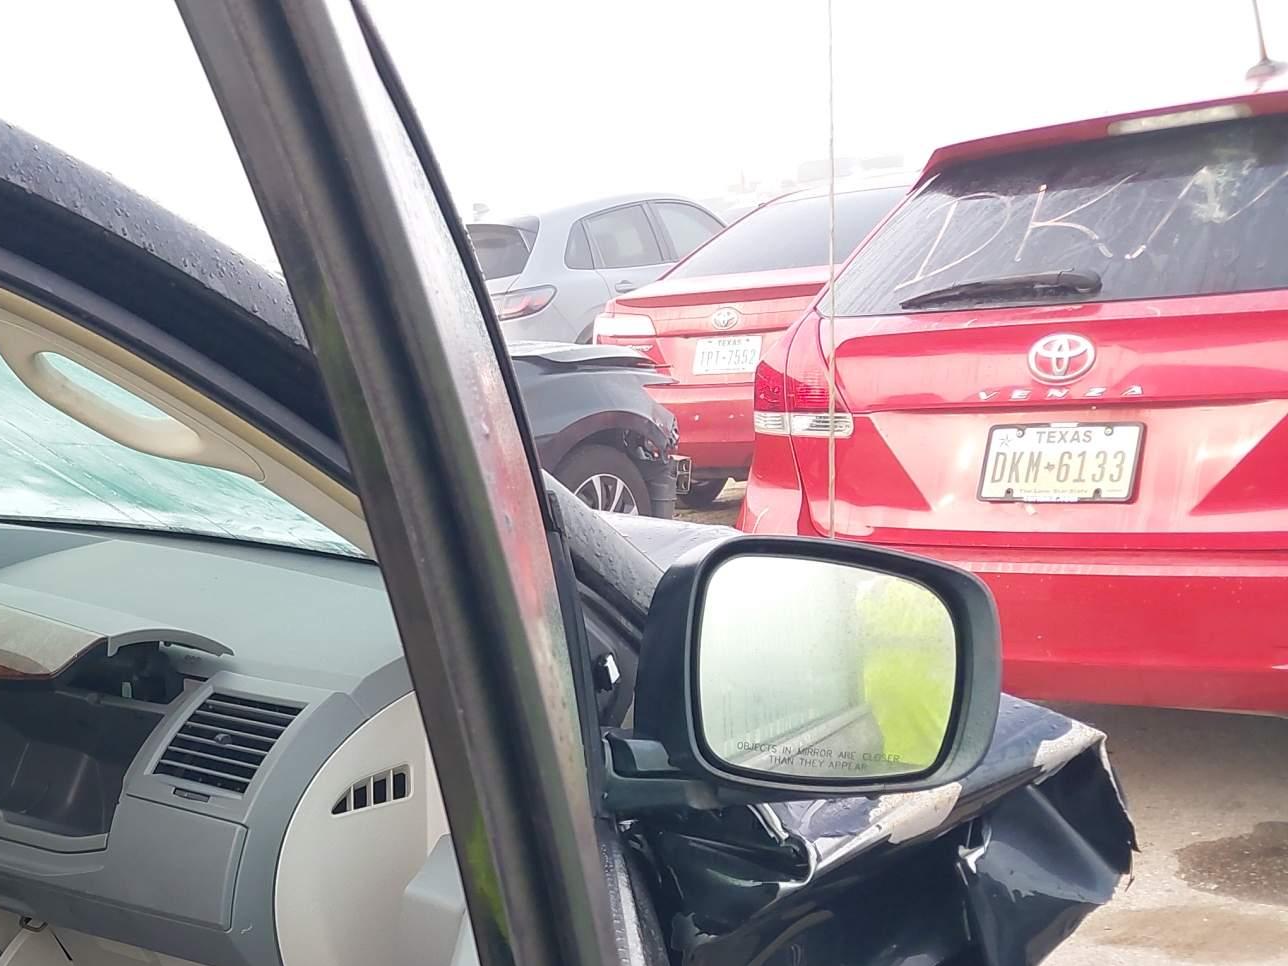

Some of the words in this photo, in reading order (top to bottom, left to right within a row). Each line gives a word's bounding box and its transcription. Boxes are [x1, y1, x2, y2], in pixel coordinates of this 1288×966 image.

[977, 385, 1144, 400] VENZA
[1036, 430, 1093, 444] TEXAS
[736, 740, 777, 754] OBJECTS
[782, 746, 792, 755] IN
[797, 746, 833, 758] MIRROR
[839, 750, 857, 761] ARE
[862, 752, 901, 763] CLOSER
[769, 755, 794, 766] THAN
[799, 757, 823, 768] THEY
[828, 760, 868, 771] APPEAR
